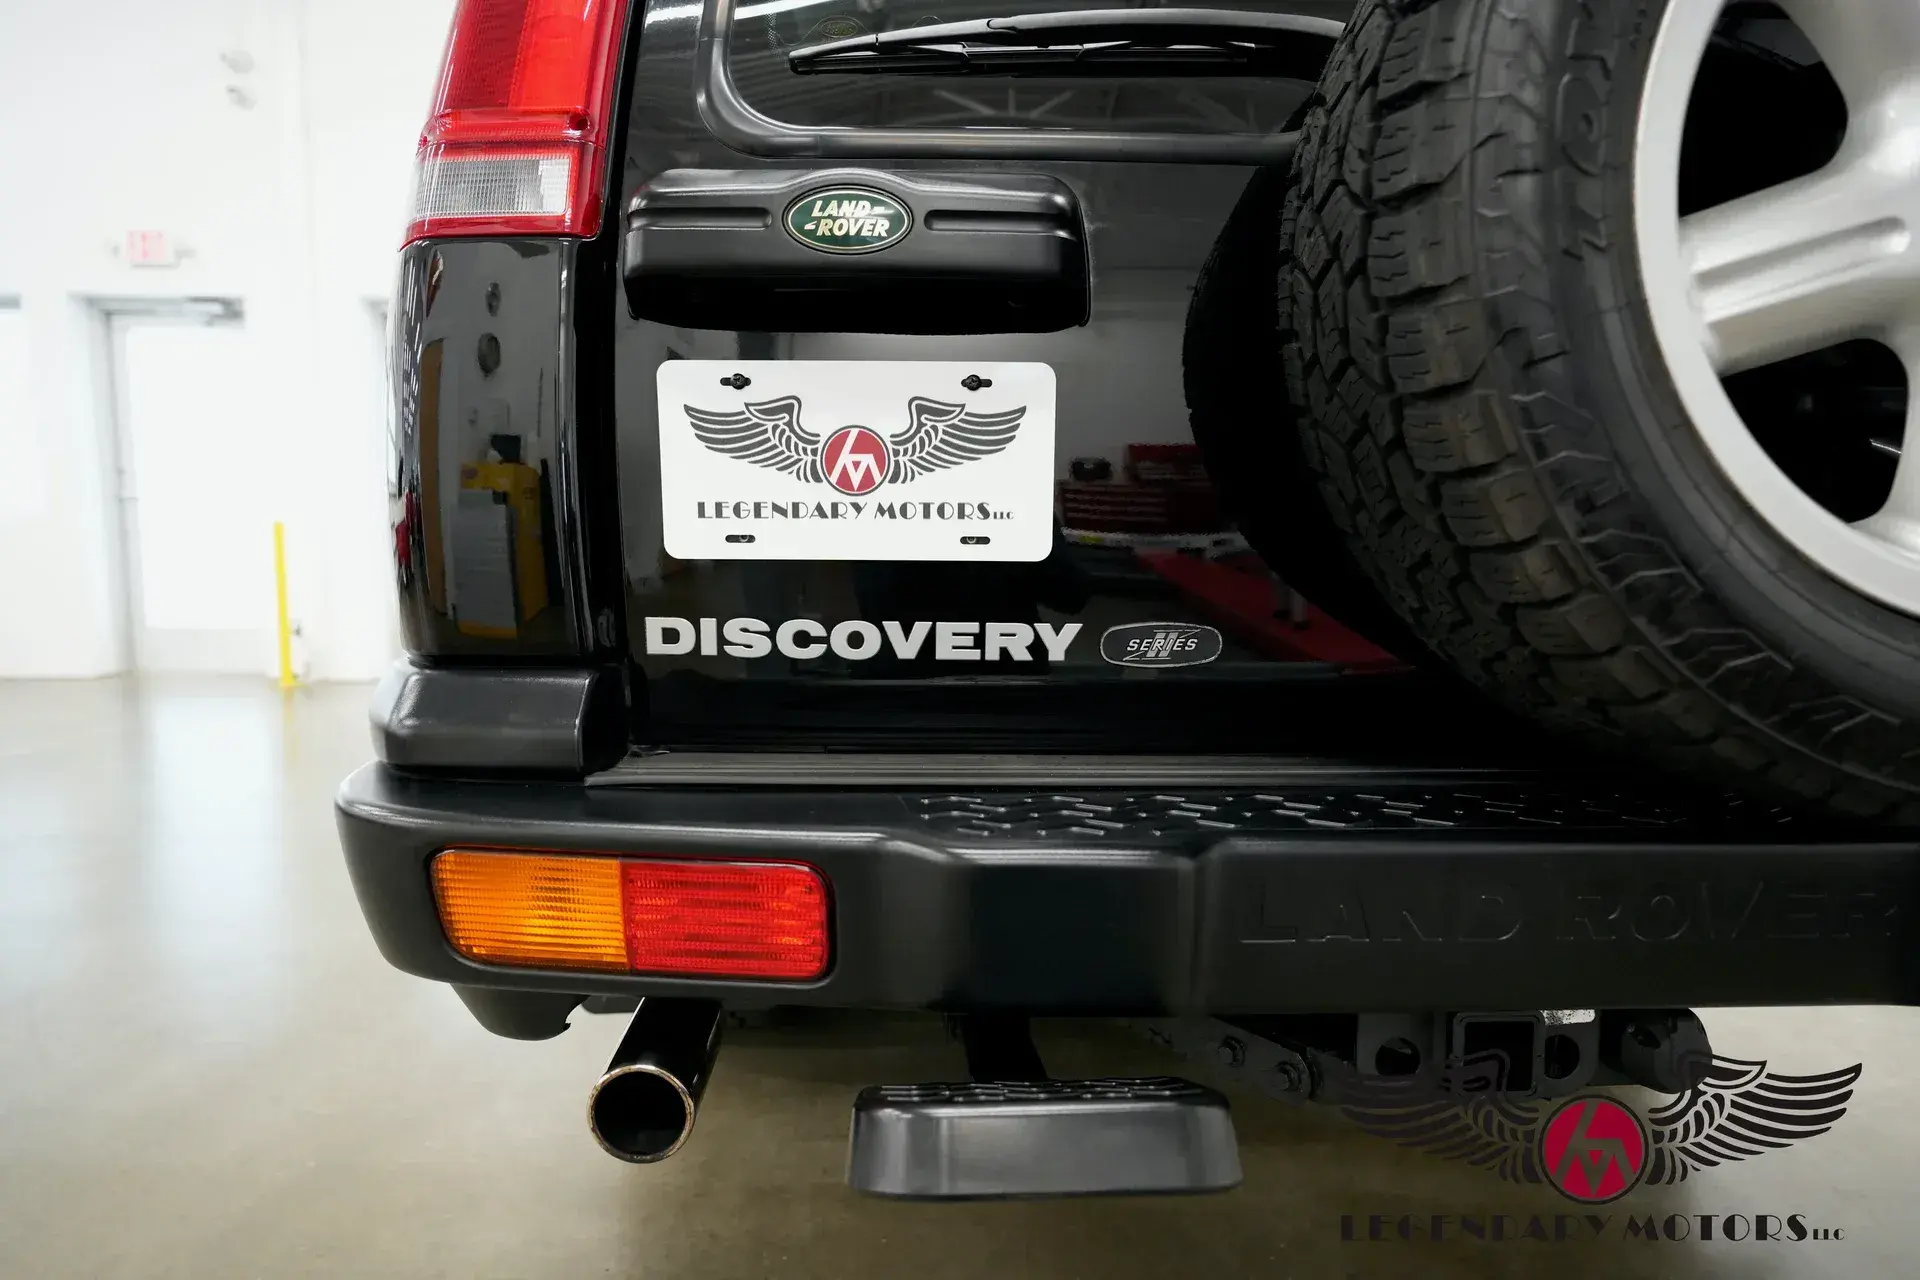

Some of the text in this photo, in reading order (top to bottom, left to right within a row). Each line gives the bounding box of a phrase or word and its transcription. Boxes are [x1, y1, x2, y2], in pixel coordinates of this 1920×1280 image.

[811, 200, 872, 217] LAND
[816, 218, 890, 237] ROVER
[696, 501, 1015, 520] LEGENDARY MOTORS LLC
[644, 616, 1084, 662] DISCOVERY
[1126, 638, 1199, 651] SERIES
[1239, 880, 1525, 943] LAND
